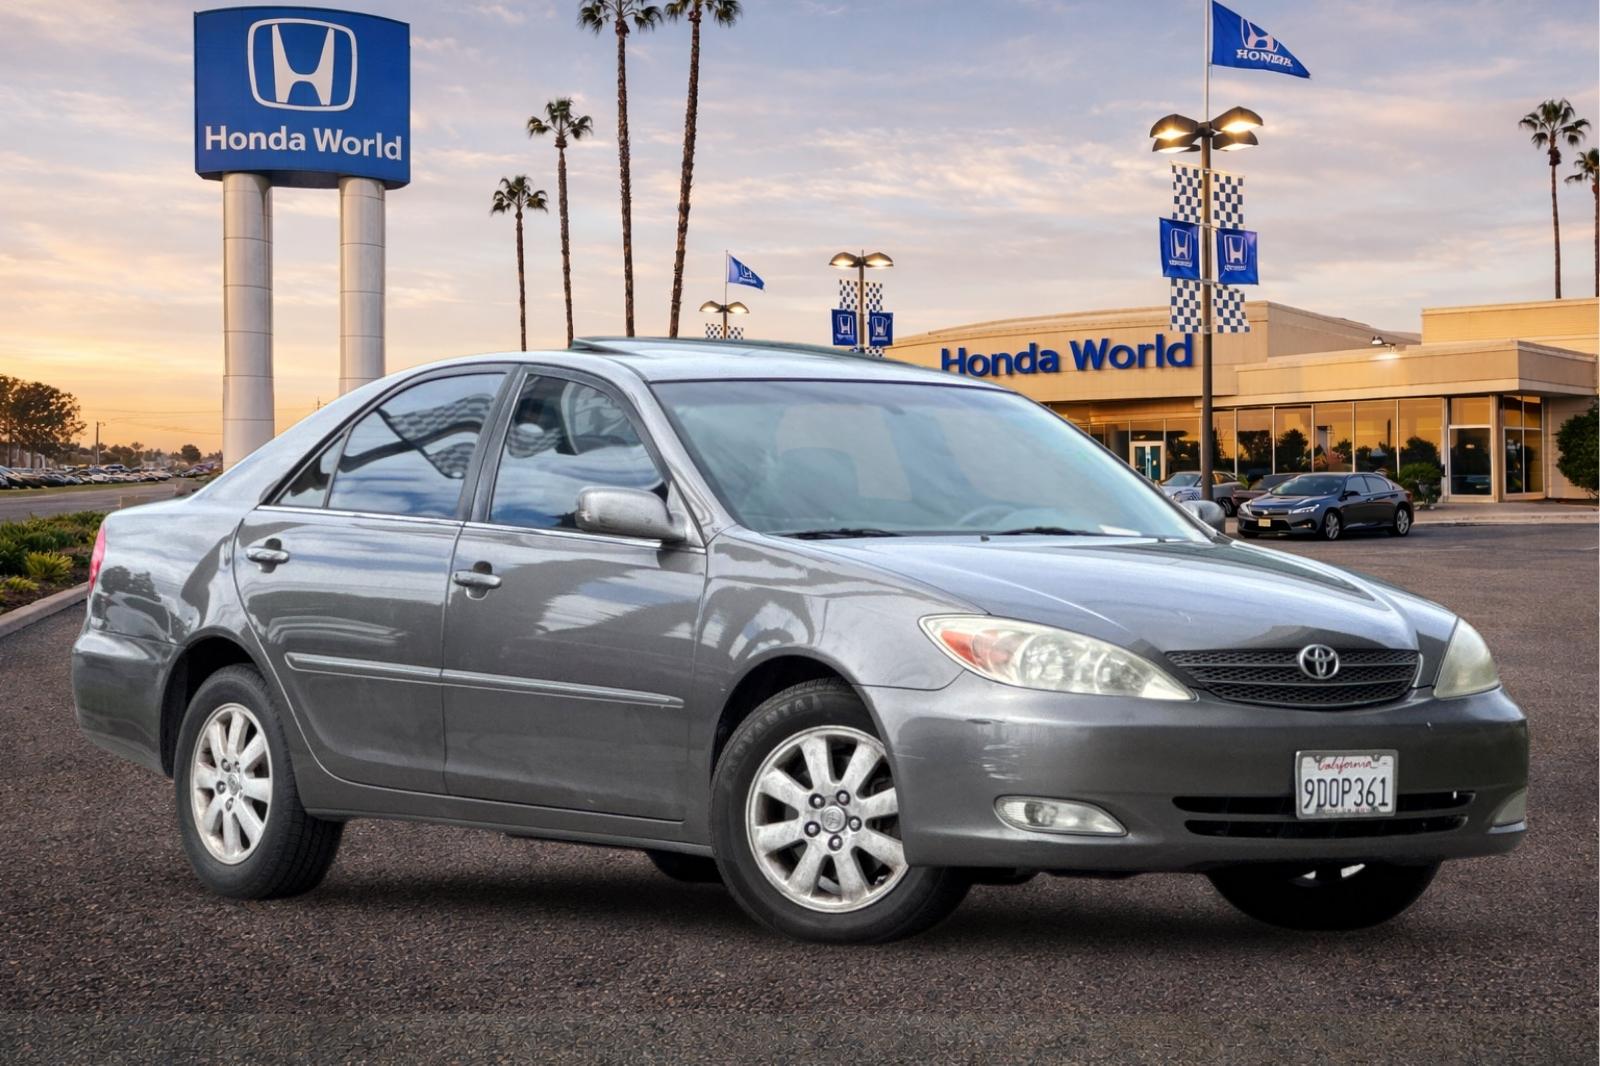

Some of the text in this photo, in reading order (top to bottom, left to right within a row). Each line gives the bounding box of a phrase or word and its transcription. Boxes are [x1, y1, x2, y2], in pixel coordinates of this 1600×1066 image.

[205, 125, 402, 160] Honda World
[941, 333, 1194, 377] Honda World
[1318, 757, 1374, 774] California
